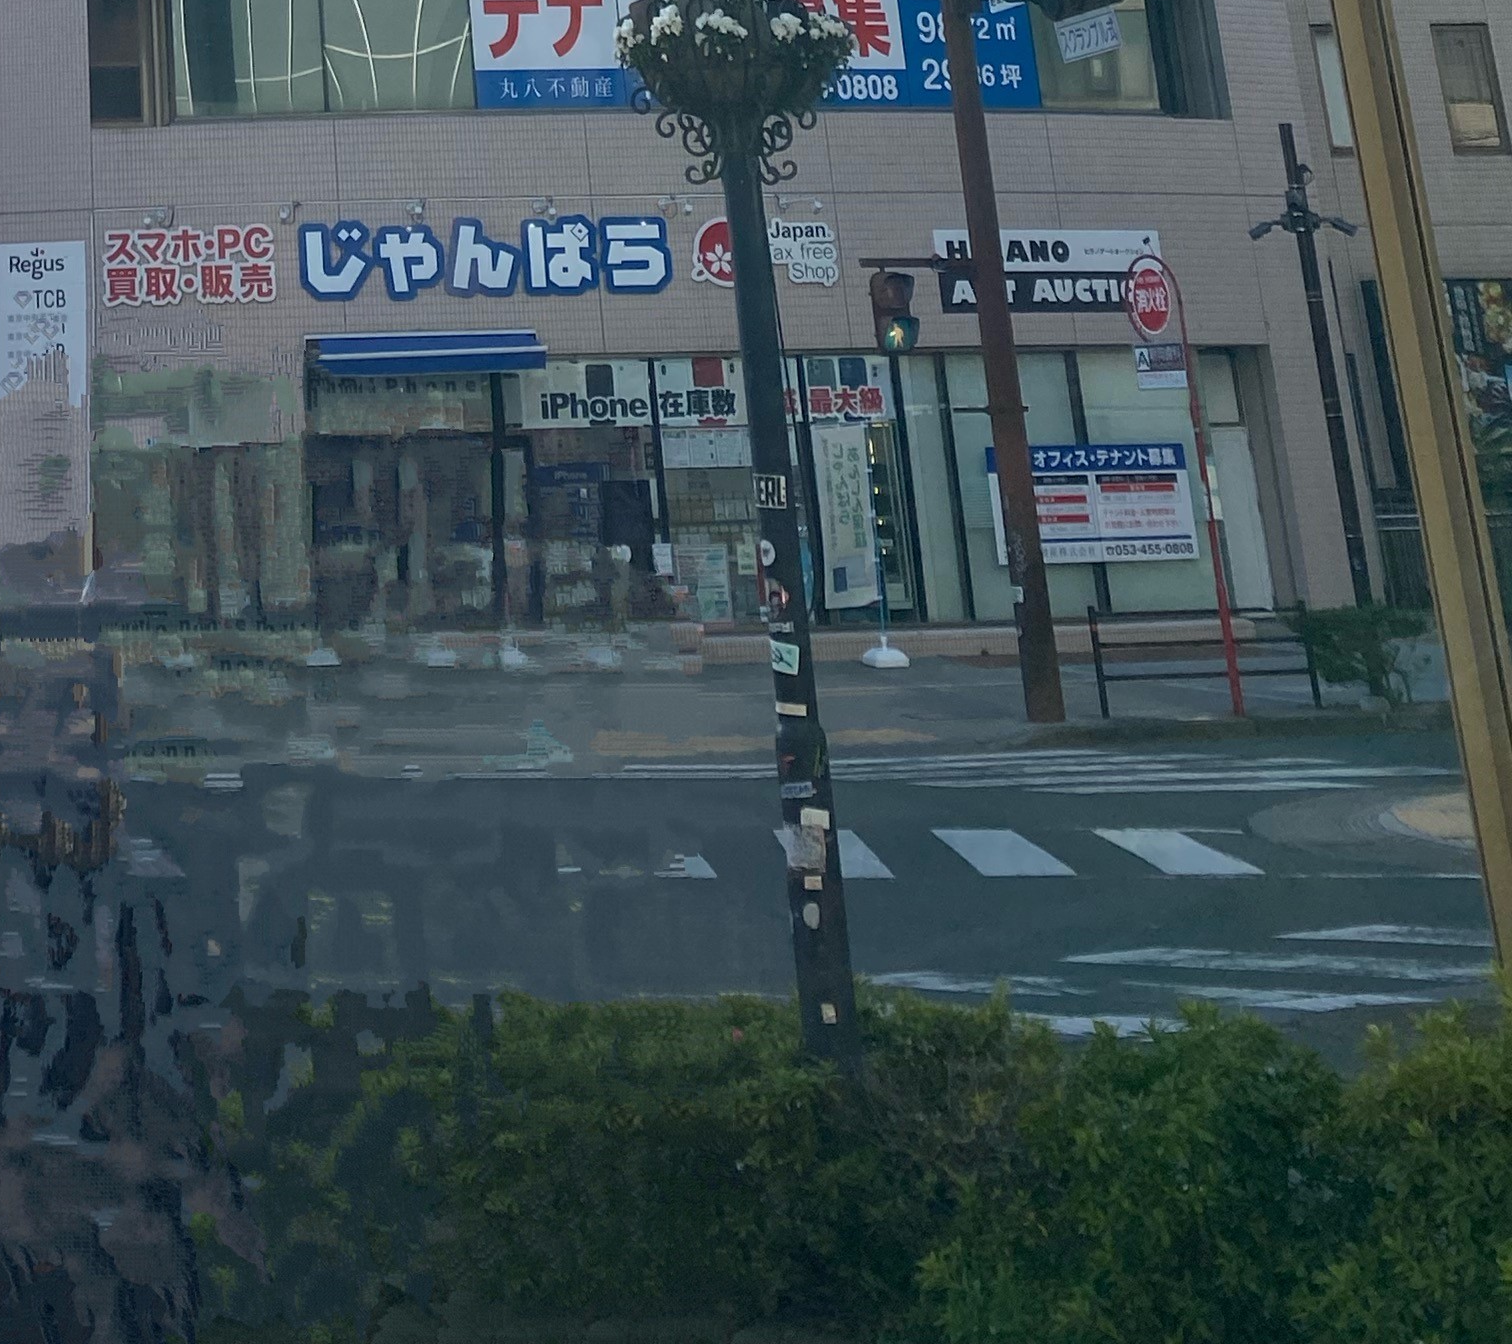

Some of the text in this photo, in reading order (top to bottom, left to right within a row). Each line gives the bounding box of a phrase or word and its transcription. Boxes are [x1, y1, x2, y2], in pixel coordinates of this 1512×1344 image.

[499, 76, 614, 99] 丸八不動産
[106, 226, 274, 263] スマホ・PC
[801, 243, 834, 260] free
[946, 240, 1070, 263] HANO
[9, 255, 65, 280] Regus
[300, 218, 670, 298] じゃんぱら
[106, 264, 276, 303] 買取・販売
[792, 262, 836, 283] Shop
[34, 290, 66, 309] TCB
[952, 278, 1138, 304] AT AUCTI
[1137, 287, 1168, 313] 消火栓
[541, 392, 649, 420] iPhone
[659, 389, 737, 418] 在庫数
